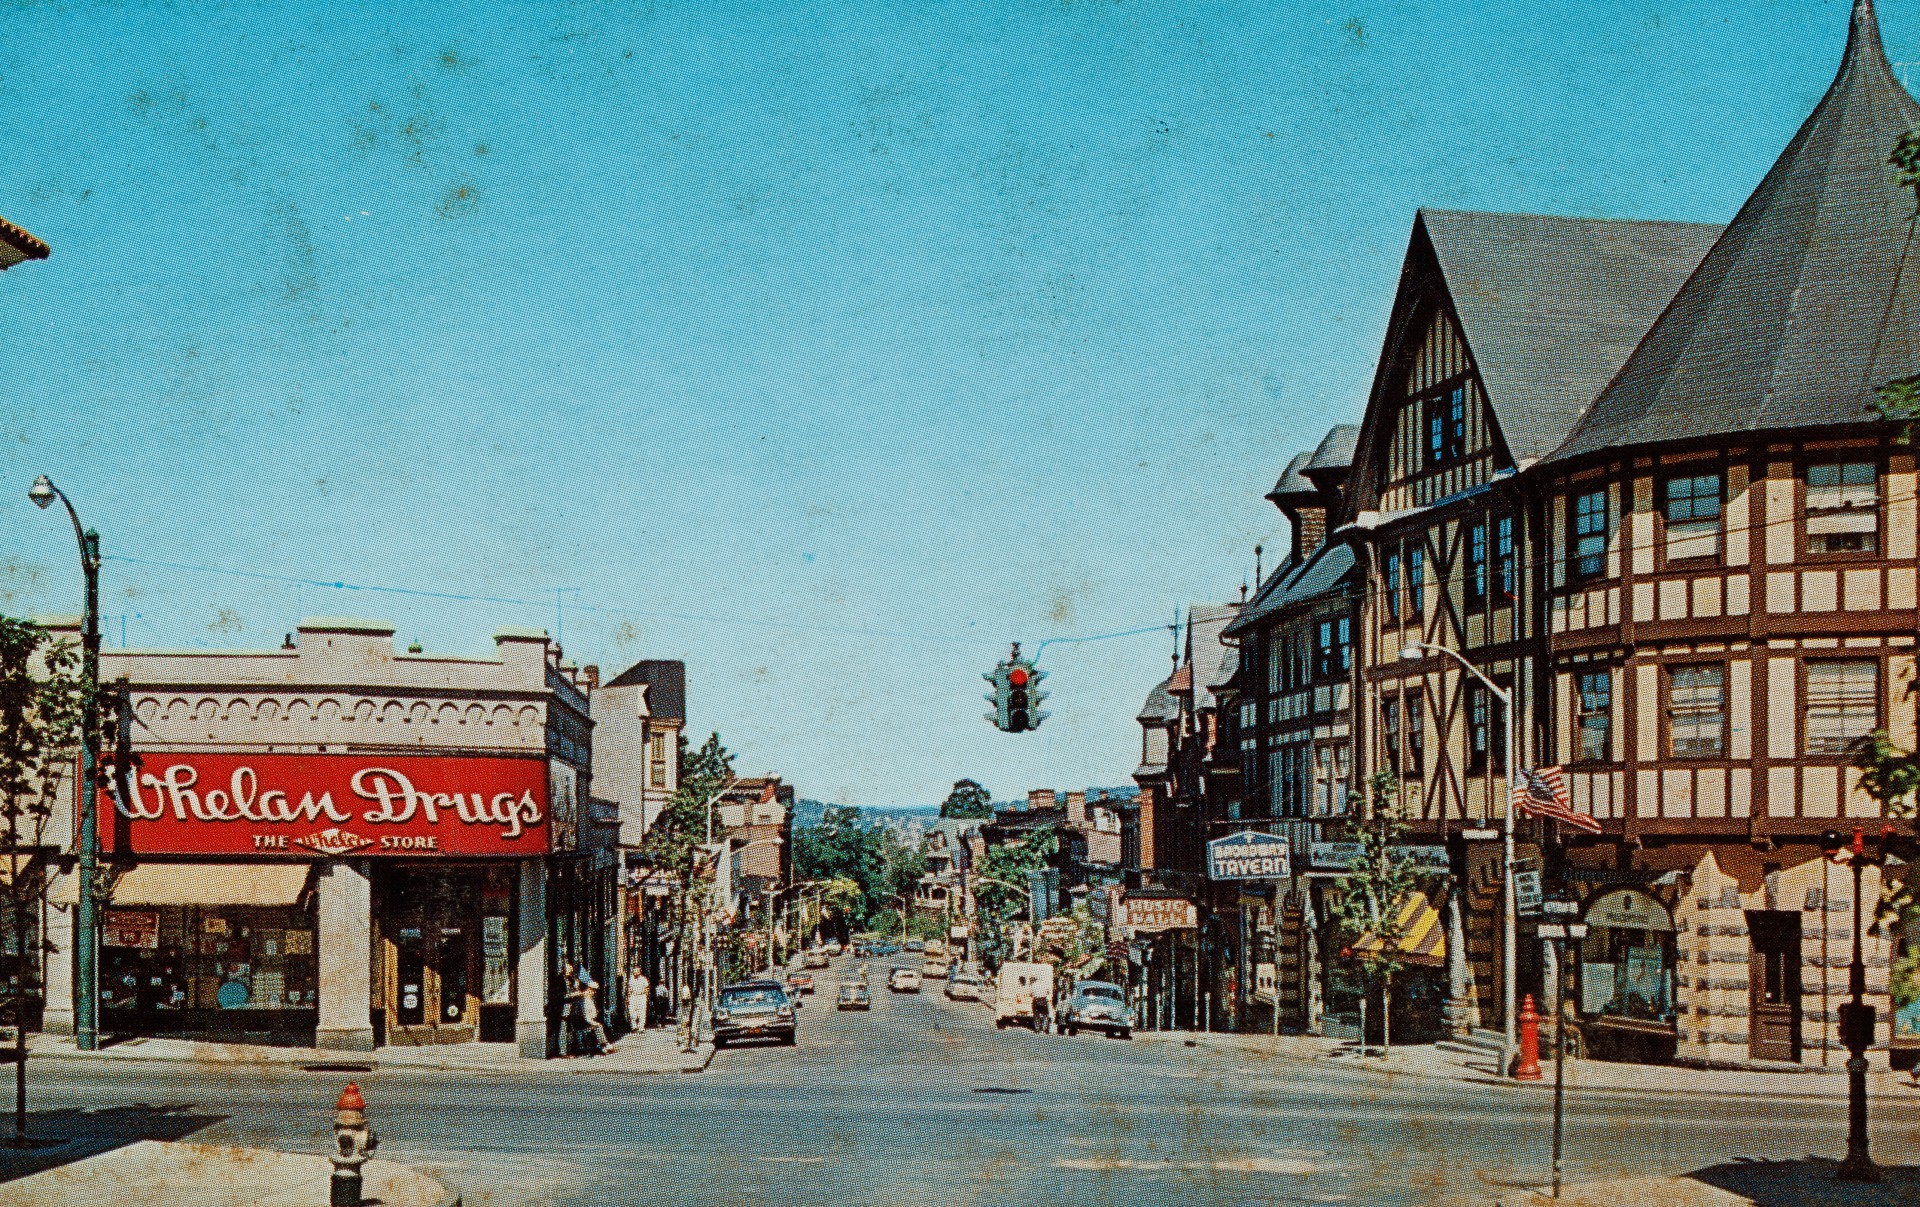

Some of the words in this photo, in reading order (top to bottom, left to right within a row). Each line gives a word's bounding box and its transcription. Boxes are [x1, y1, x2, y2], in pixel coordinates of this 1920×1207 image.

[104, 764, 351, 823] Whelan
[351, 767, 544, 839] Drugs
[252, 834, 289, 849] THE
[380, 836, 438, 850] STORE
[1214, 843, 1287, 859] BROADWAY
[1215, 858, 1288, 876] TAVERN
[1129, 899, 1184, 913] MUSIC
